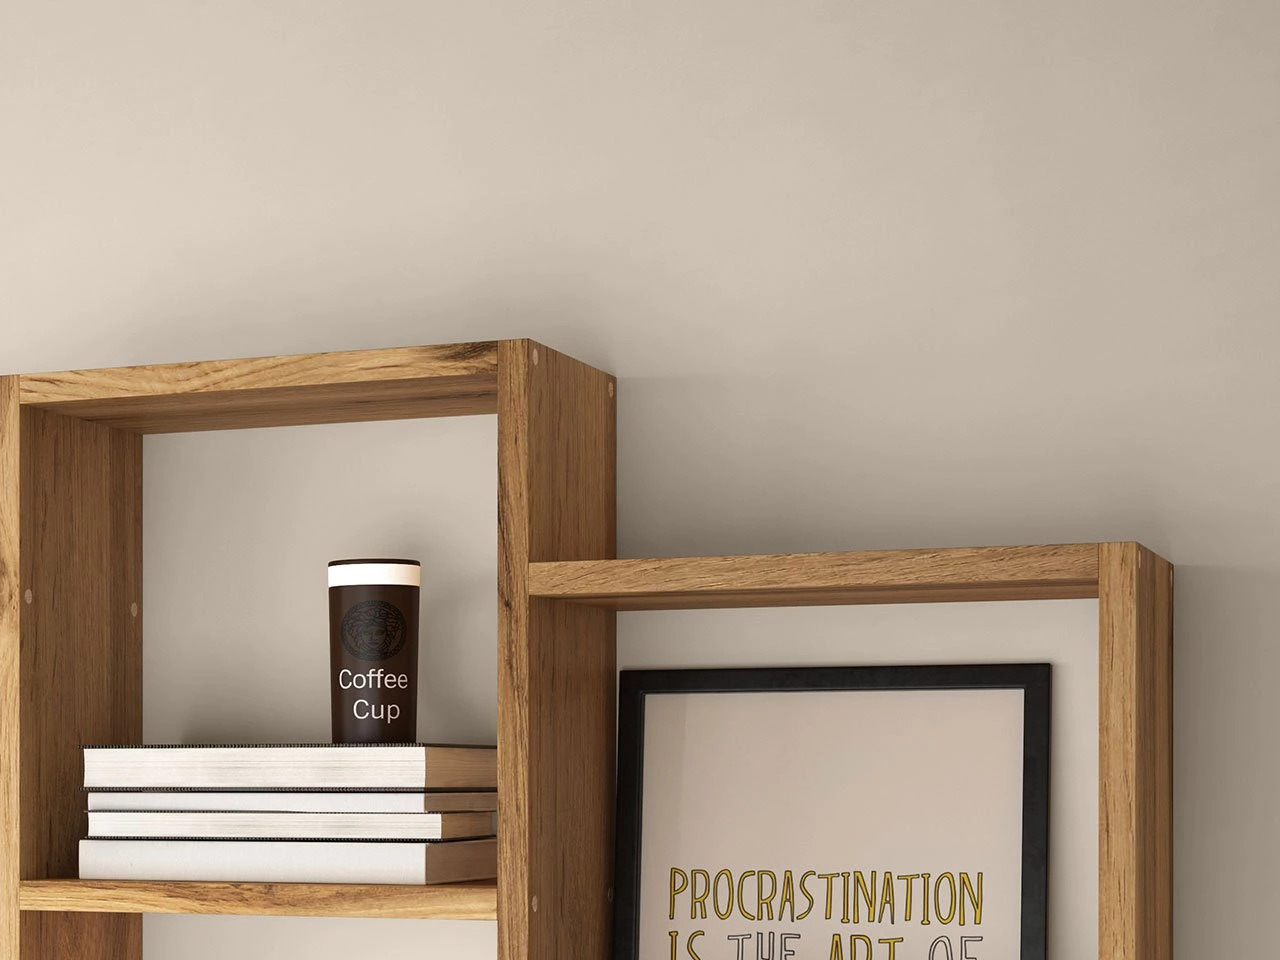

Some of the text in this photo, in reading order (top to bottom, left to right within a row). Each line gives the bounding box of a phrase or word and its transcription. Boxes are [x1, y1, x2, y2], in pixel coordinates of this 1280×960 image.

[339, 668, 408, 689] Coffee
[353, 699, 401, 724] Cup
[668, 867, 983, 926] PROCRASTINATION
